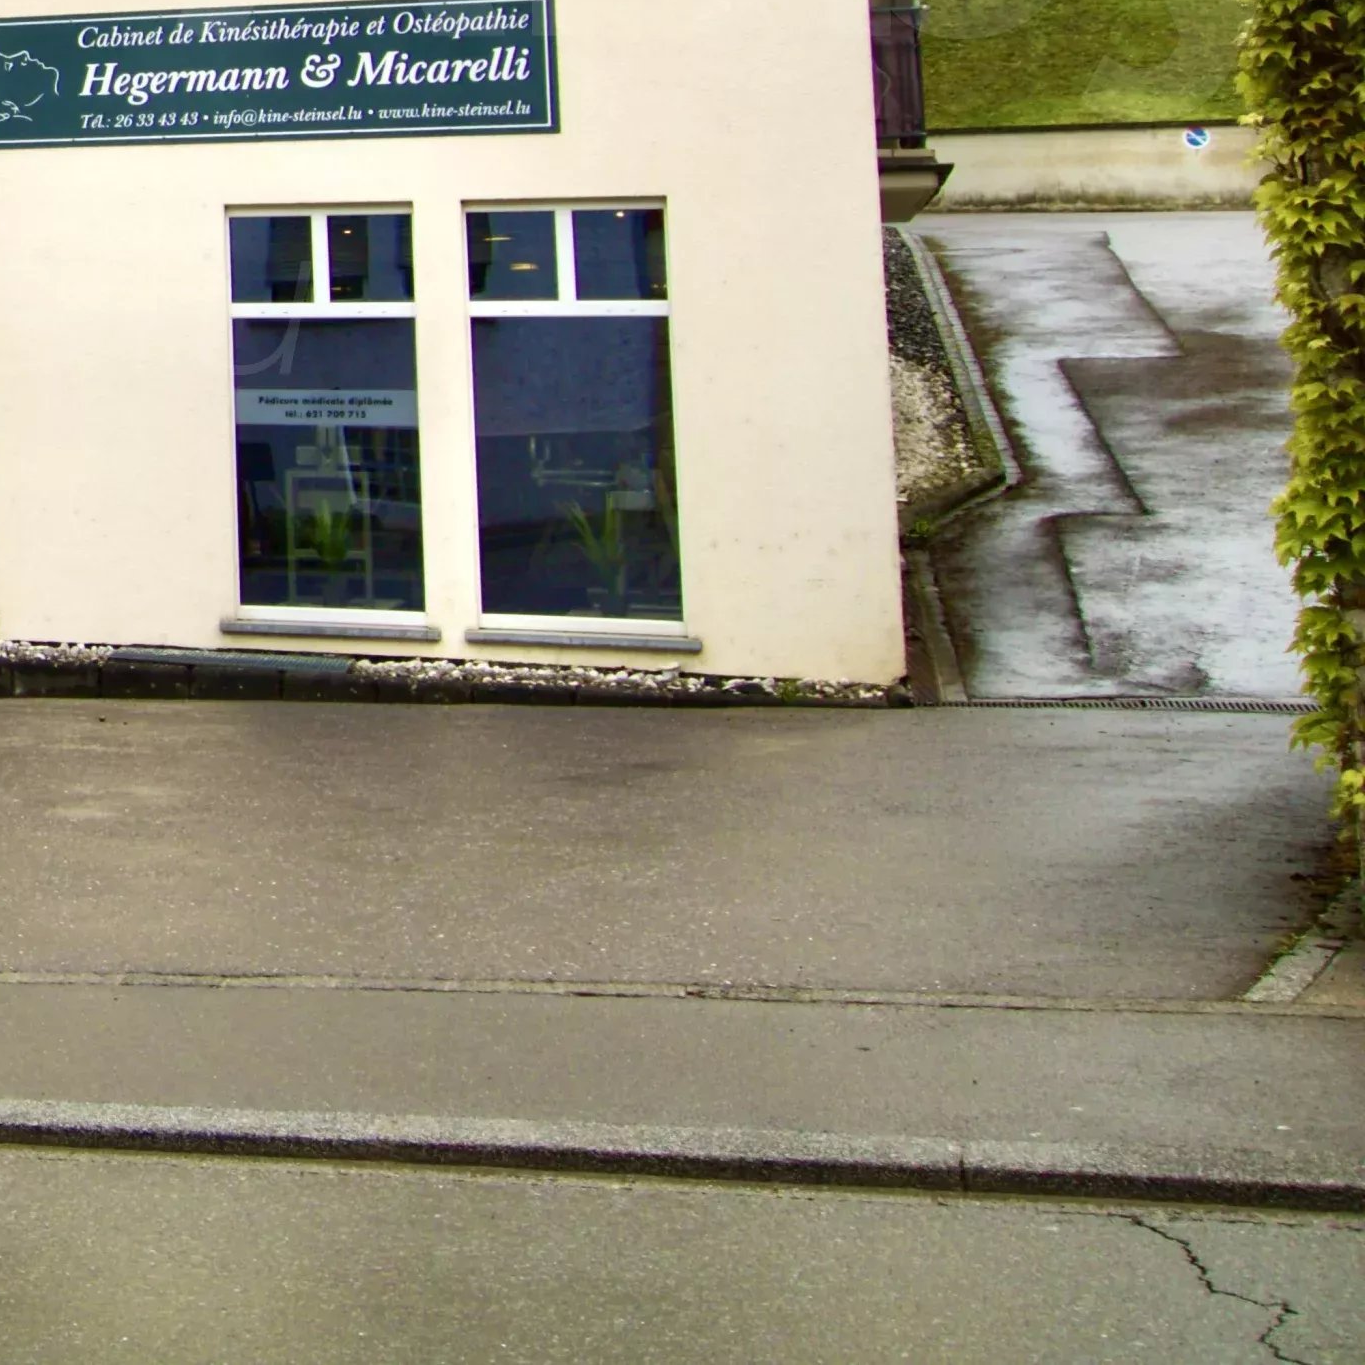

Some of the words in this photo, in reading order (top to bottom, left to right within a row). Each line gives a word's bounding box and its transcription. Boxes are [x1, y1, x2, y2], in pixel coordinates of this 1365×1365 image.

[77, 25, 163, 49] Cabinet
[169, 22, 194, 45] de
[198, 15, 359, 45] Kinésithérapie
[366, 15, 385, 35] et
[393, 7, 529, 39] Ostéopathie
[78, 62, 289, 106] Hegermann
[300, 52, 342, 88] &
[347, 45, 531, 87] Micarelli
[113, 113, 133, 128] 26
[135, 112, 155, 127] 33
[158, 111, 176, 126] 43
[180, 110, 199, 126] 43
[212, 105, 362, 129] info@kine-steinsel.lu
[378, 100, 531, 120] www.kine-steinsel.lu
